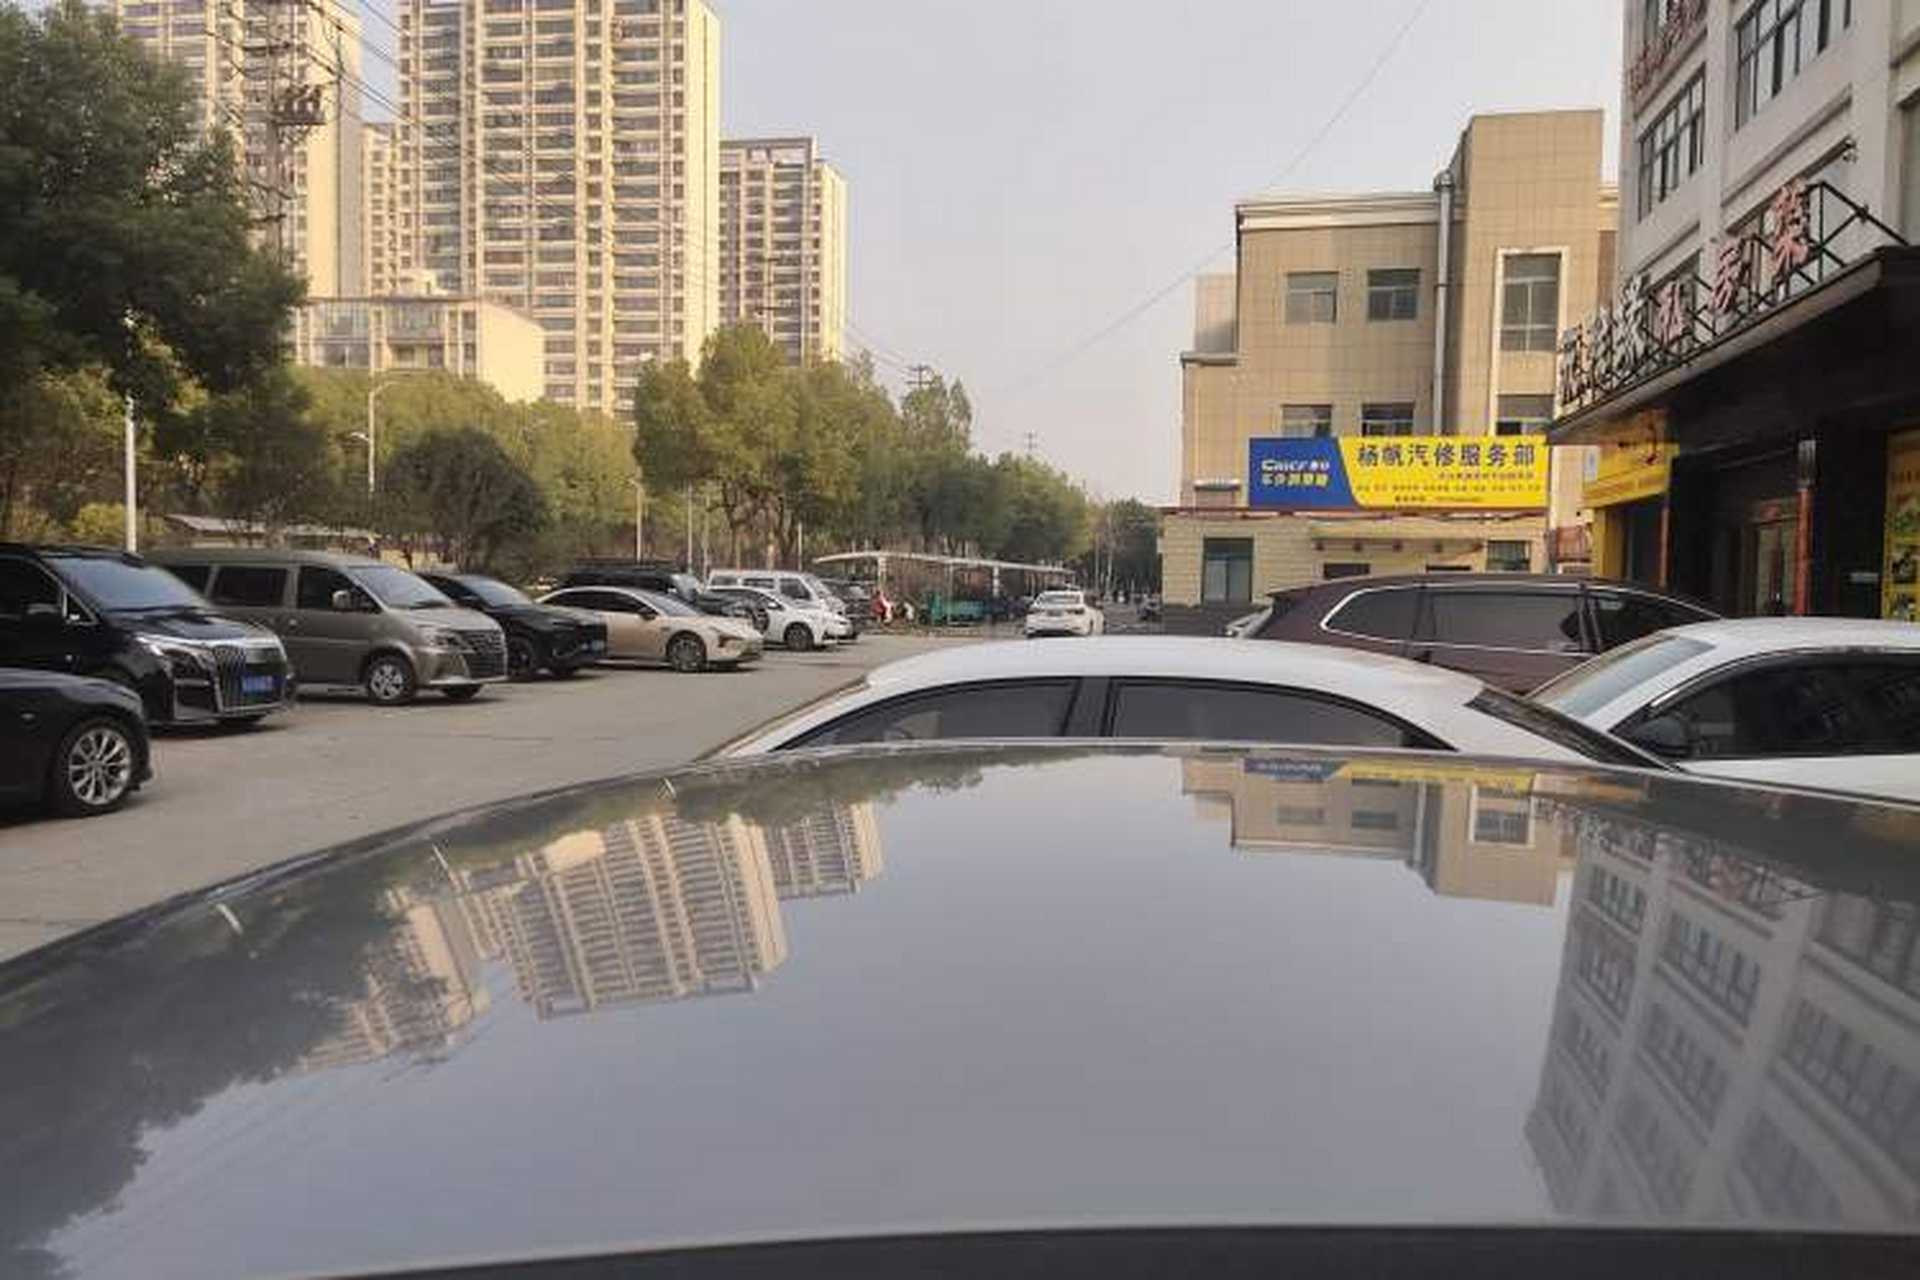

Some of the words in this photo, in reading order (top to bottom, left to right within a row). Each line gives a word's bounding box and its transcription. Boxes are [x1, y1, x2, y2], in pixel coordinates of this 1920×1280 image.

[1358, 442, 1535, 467] 杨帆汽修服务部
